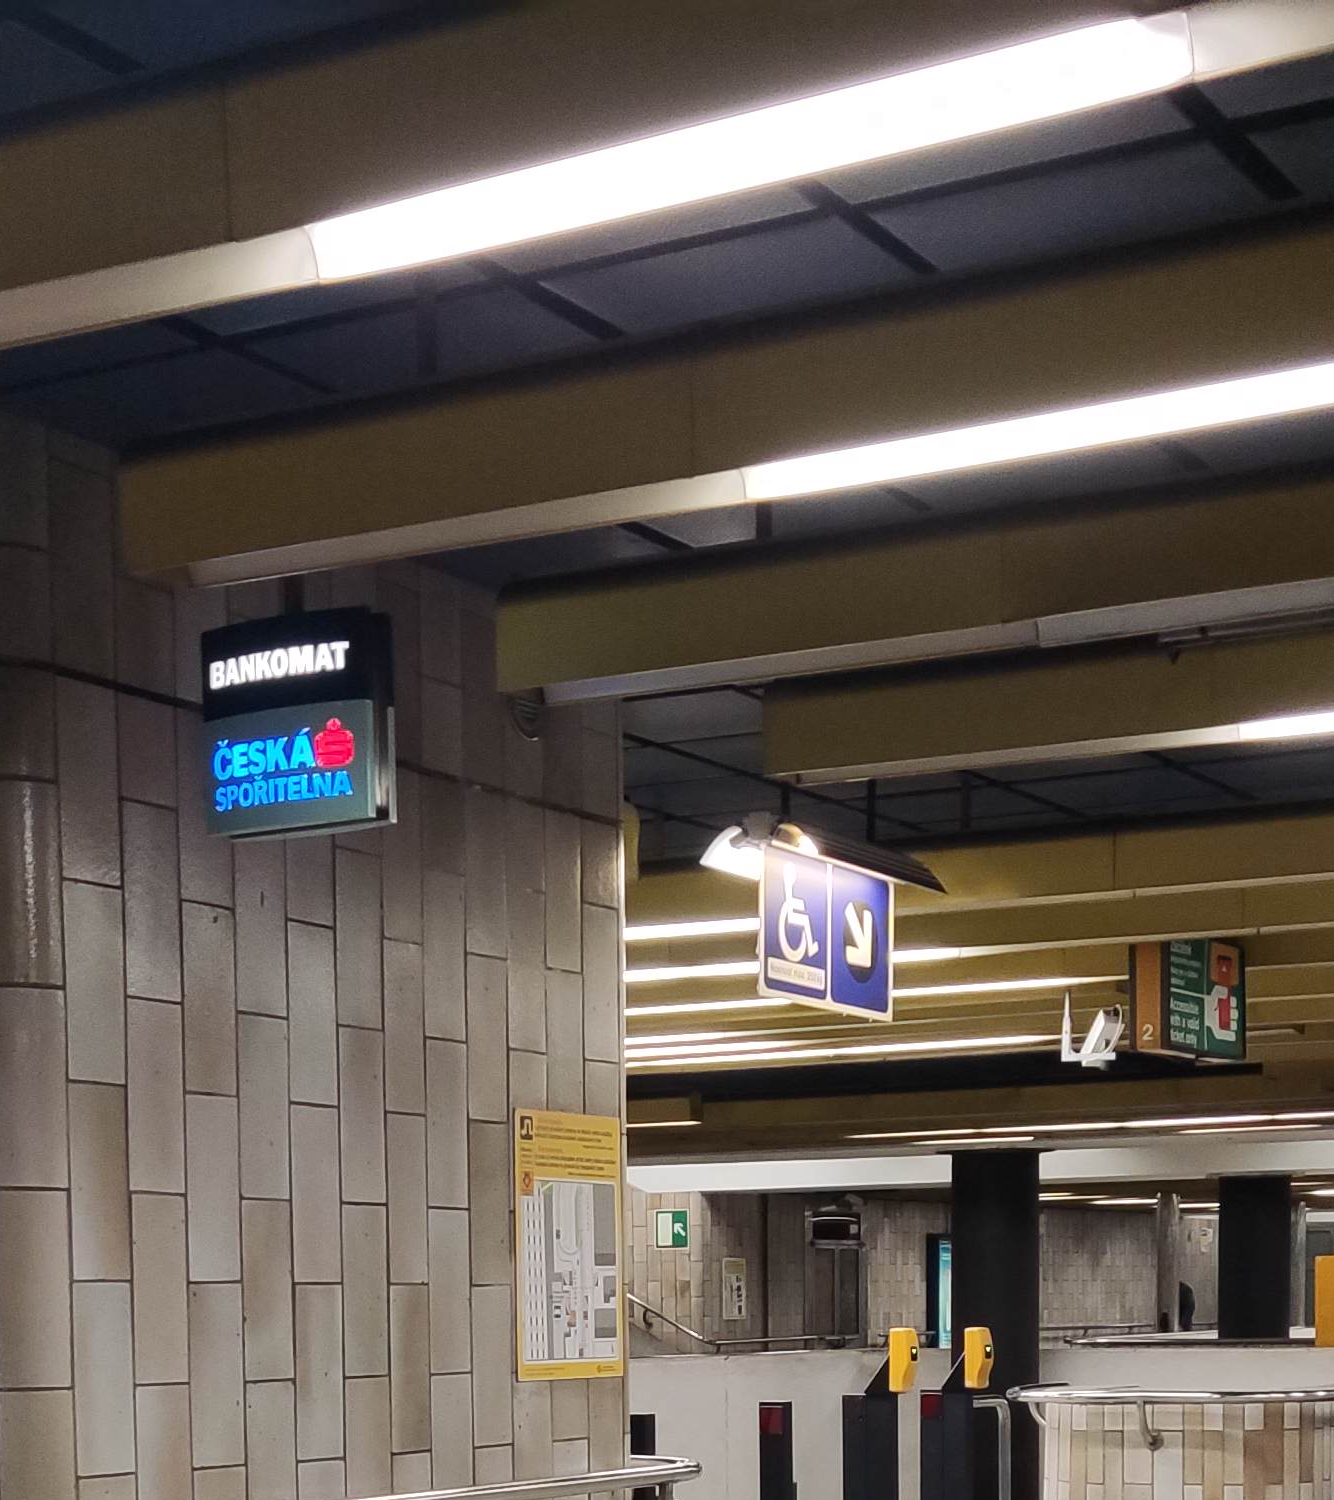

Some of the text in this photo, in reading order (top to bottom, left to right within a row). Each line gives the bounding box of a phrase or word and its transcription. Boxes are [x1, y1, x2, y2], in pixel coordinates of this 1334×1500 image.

[209, 641, 349, 690] BANKOMAT
[213, 726, 317, 781] ČESKÁ
[214, 770, 353, 813] SPOŘITELNA
[1142, 1024, 1154, 1040] 2
